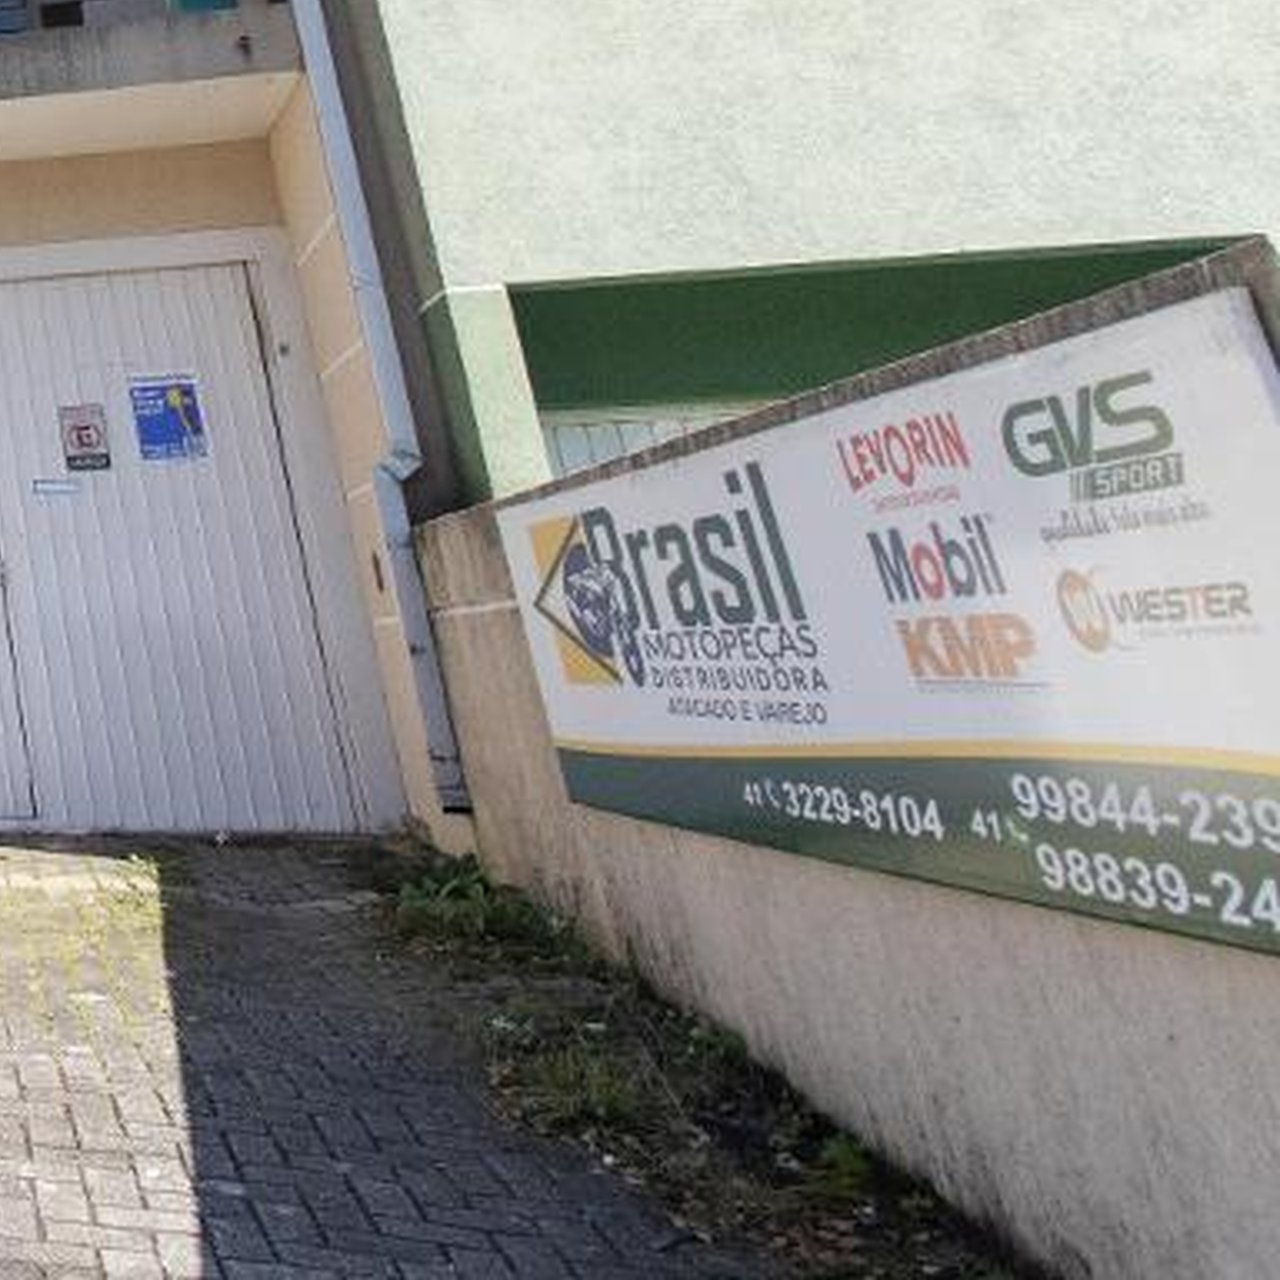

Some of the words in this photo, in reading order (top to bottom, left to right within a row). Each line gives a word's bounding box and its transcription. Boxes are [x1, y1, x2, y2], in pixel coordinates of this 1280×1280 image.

[836, 411, 970, 493] LEVORIN
[1001, 370, 1174, 477] GVS
[1092, 455, 1180, 497] SPORT
[581, 460, 807, 630] Brasil
[867, 514, 1006, 603] Mobil
[1108, 583, 1252, 623] WESTER
[643, 623, 818, 666] MOTOPEÇAS
[895, 612, 1036, 677] KMP
[649, 666, 828, 692] DISTRIBUIDORA
[740, 699, 753, 721] E
[756, 701, 828, 725] VAREJO
[743, 782, 763, 807] 41
[782, 781, 944, 841] 3229-8104
[971, 809, 1001, 842] 41
[1012, 774, 1280, 854] 99844-239
[1036, 843, 1280, 932] 98839-24
